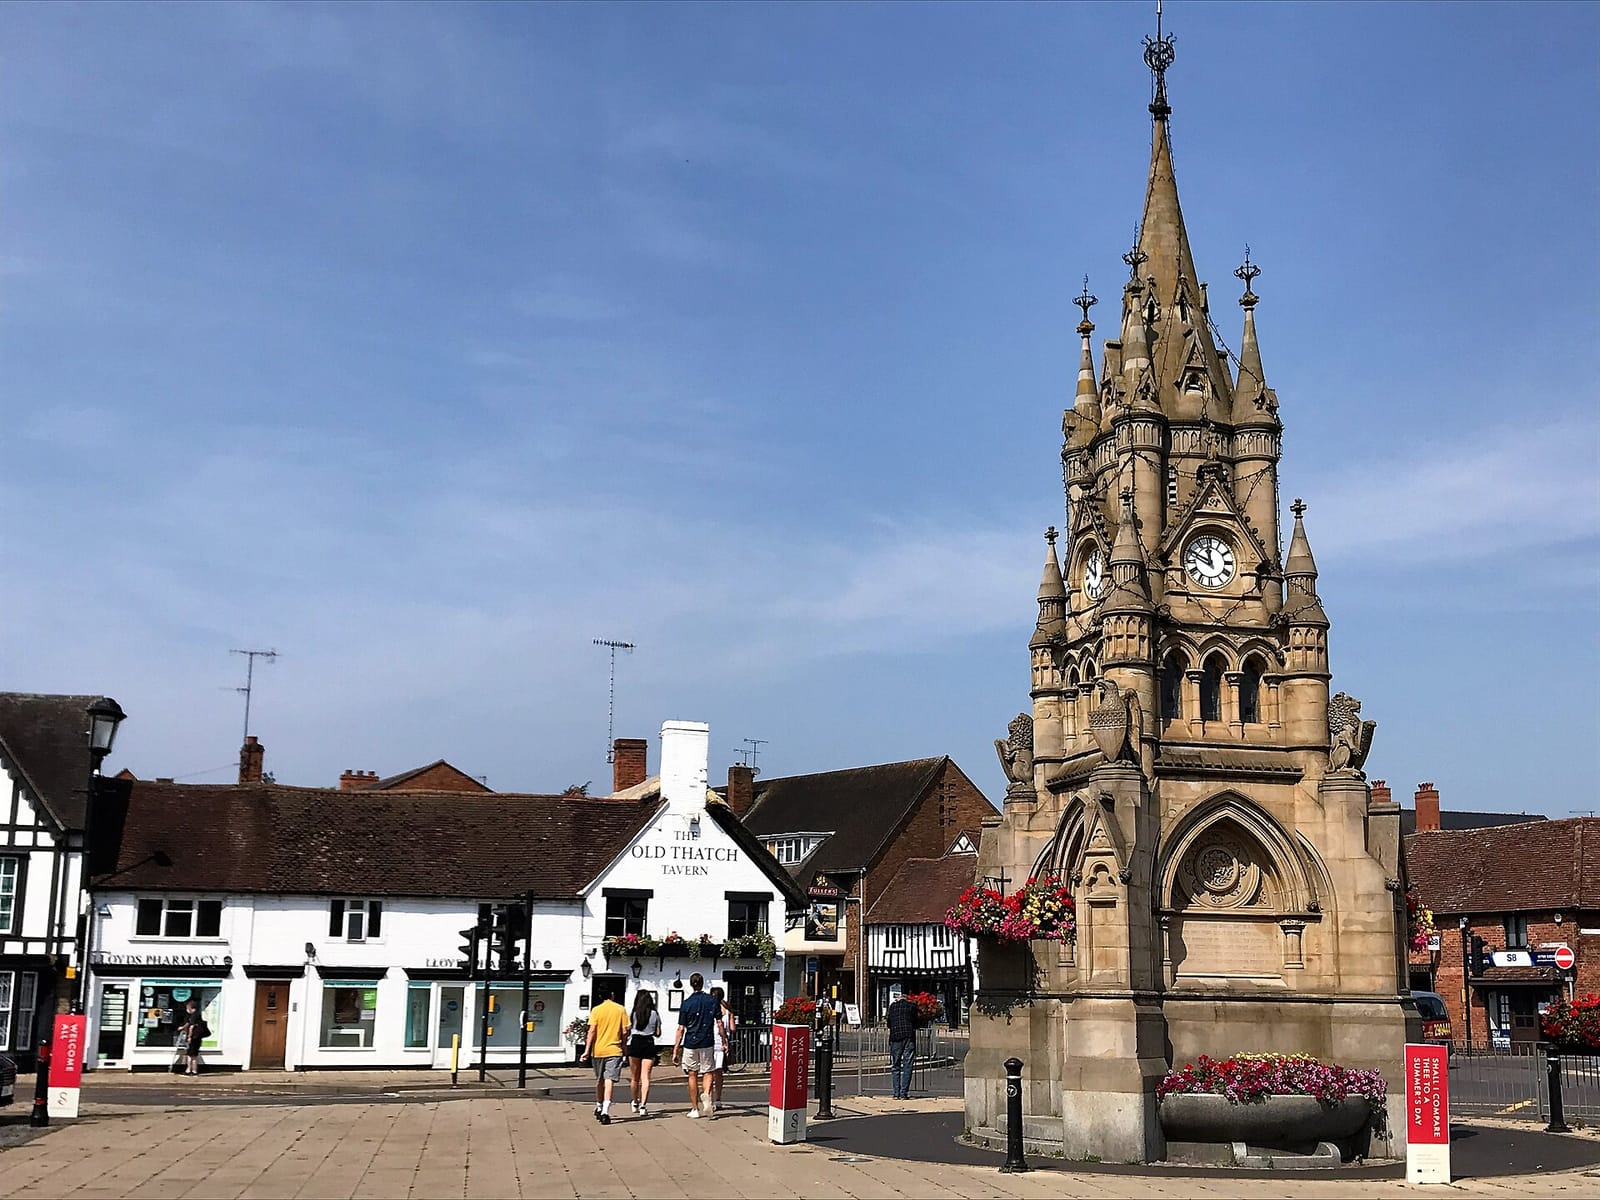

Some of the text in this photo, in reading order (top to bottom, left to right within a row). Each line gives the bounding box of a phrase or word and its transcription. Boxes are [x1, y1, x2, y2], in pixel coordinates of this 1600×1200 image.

[674, 830, 699, 841] THE
[631, 845, 738, 862] OLD THATCH
[661, 864, 709, 876] TAVERN
[146, 954, 218, 966] PHARMACY
[1506, 953, 1517, 962] S8
[60, 1023, 69, 1041] ALL
[66, 1023, 79, 1072] WELCOME
[1432, 1057, 1440, 1081] SHALL
[1422, 1057, 1431, 1104] THEE TO A
[1413, 1057, 1423, 1126] SUMMER'S DAY
[1432, 1093, 1441, 1138] COMPARE
